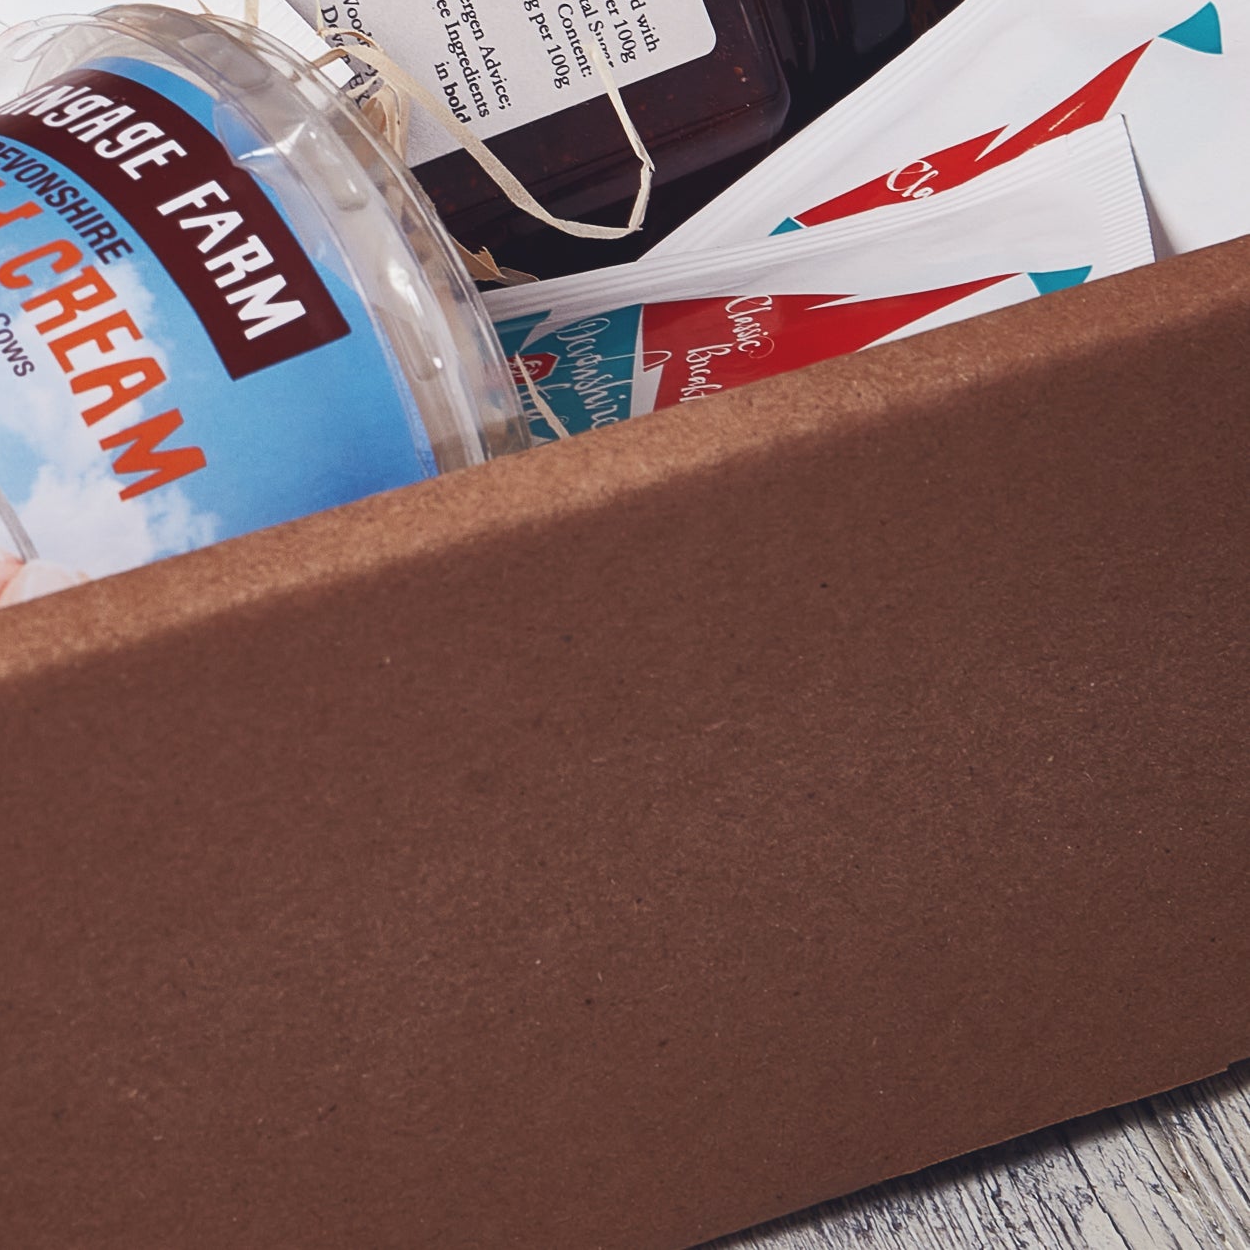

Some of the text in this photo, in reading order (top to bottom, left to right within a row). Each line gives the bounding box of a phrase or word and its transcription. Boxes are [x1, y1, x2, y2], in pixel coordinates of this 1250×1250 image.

[529, 12, 554, 41] per
[547, 44, 570, 89] 100g
[557, 3, 592, 78] Content:
[614, 19, 637, 64] 100g
[636, 14, 660, 53] with
[434, 61, 472, 125] in bold
[444, 21, 490, 118] Ingredients
[479, 45, 512, 111] Advice;
[157, 180, 307, 342] FARM
[725, 294, 774, 359] Classic
[556, 318, 629, 429] Devonshire
